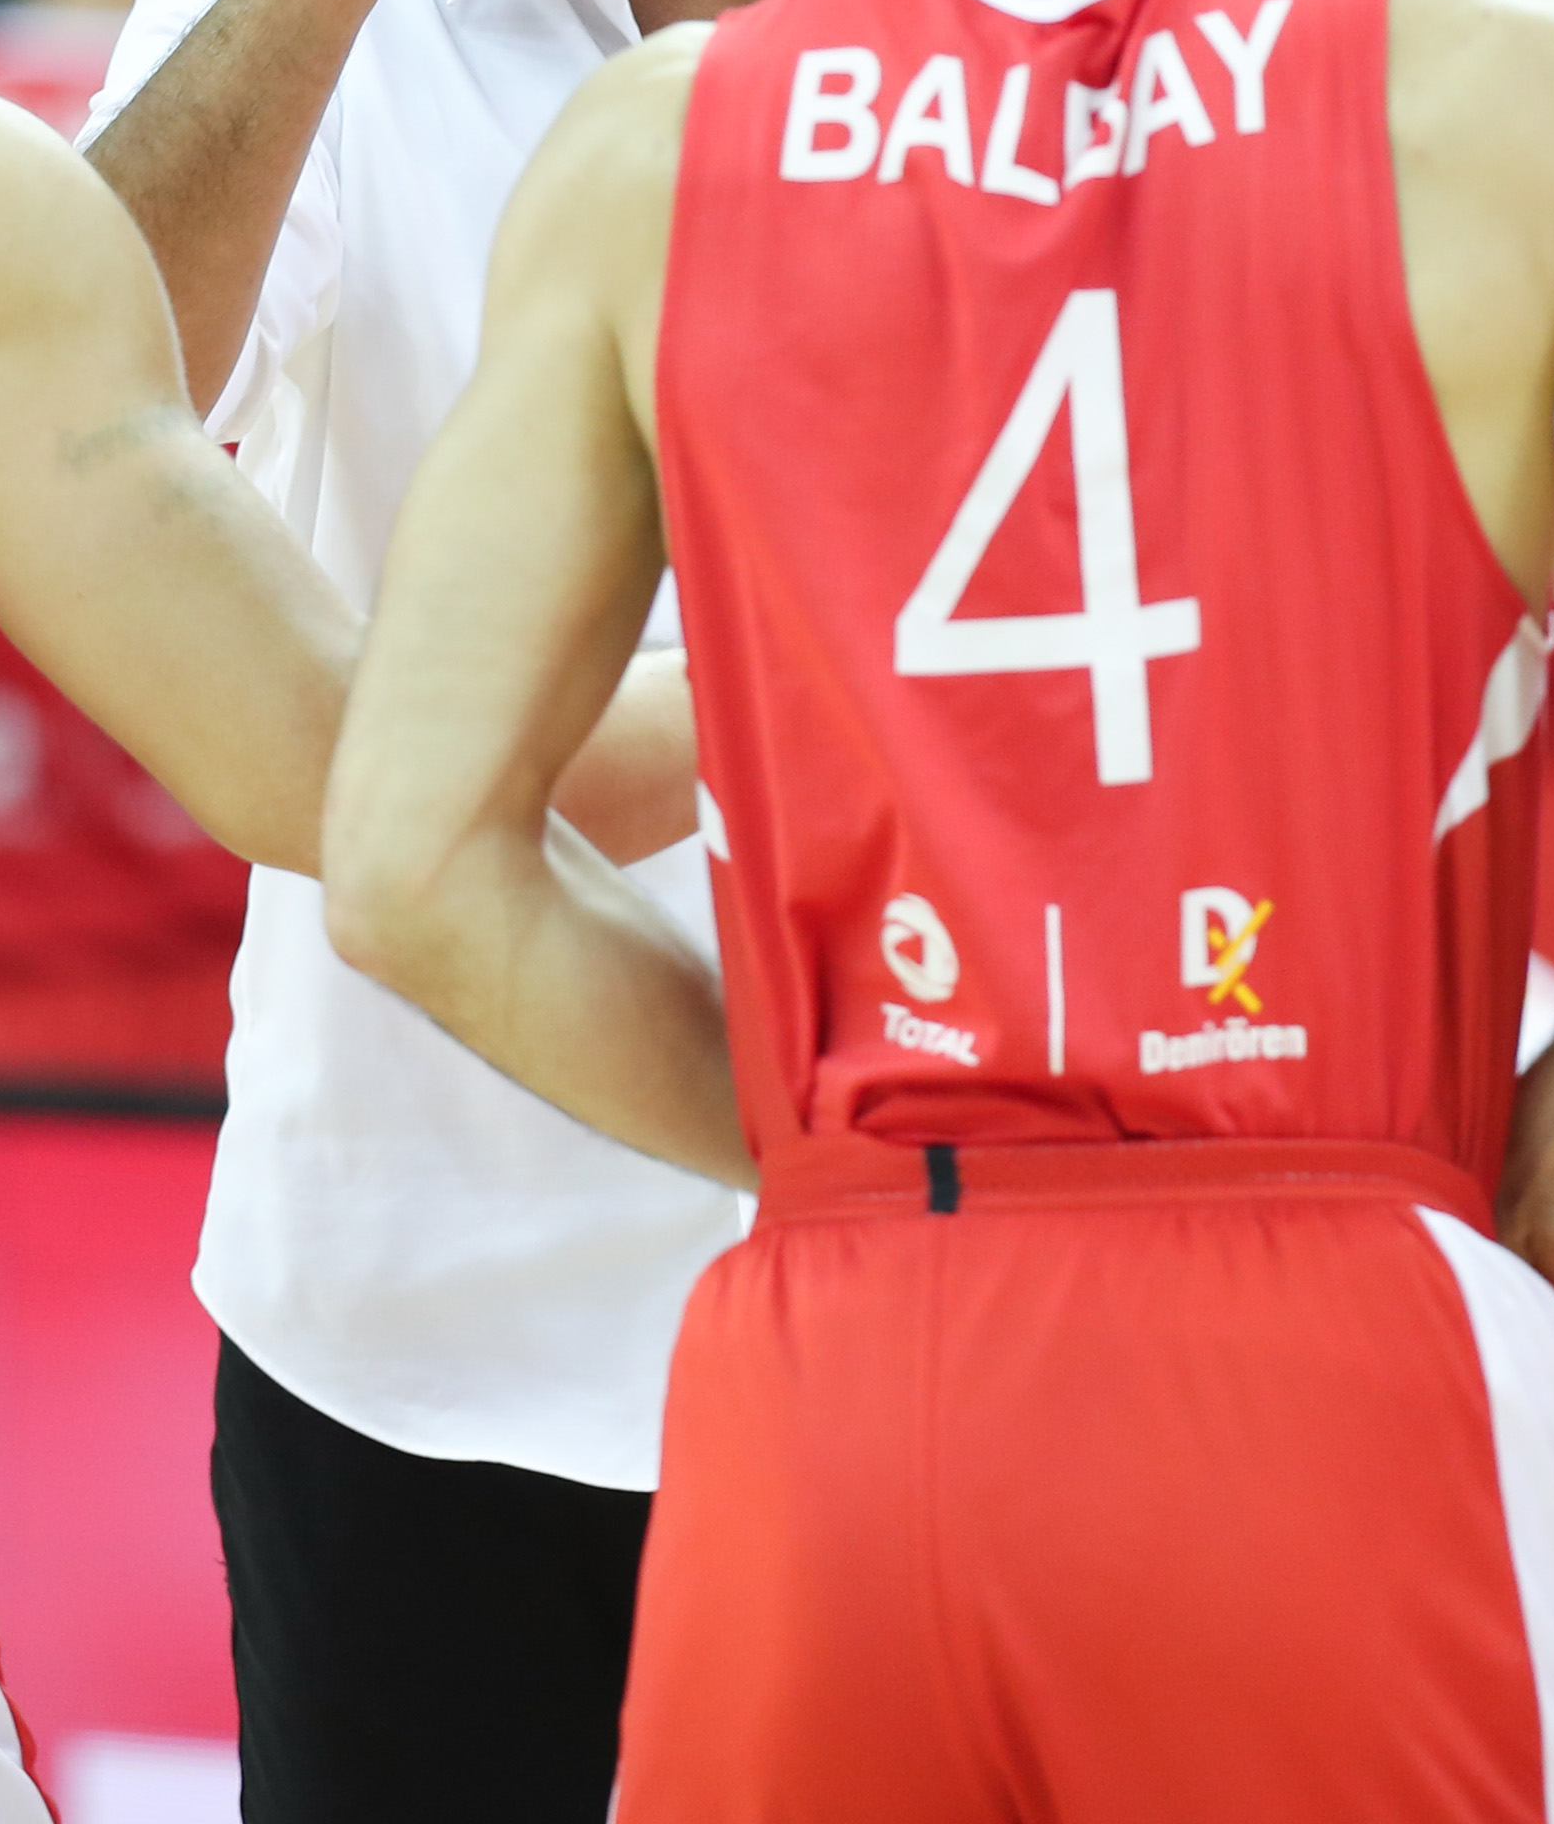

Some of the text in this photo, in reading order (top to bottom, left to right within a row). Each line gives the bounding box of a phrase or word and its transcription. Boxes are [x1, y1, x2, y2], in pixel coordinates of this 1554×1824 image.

[893, 288, 1202, 786] 4
[880, 1002, 981, 1066] TOTAL
[1139, 1016, 1308, 1074] Demirören
